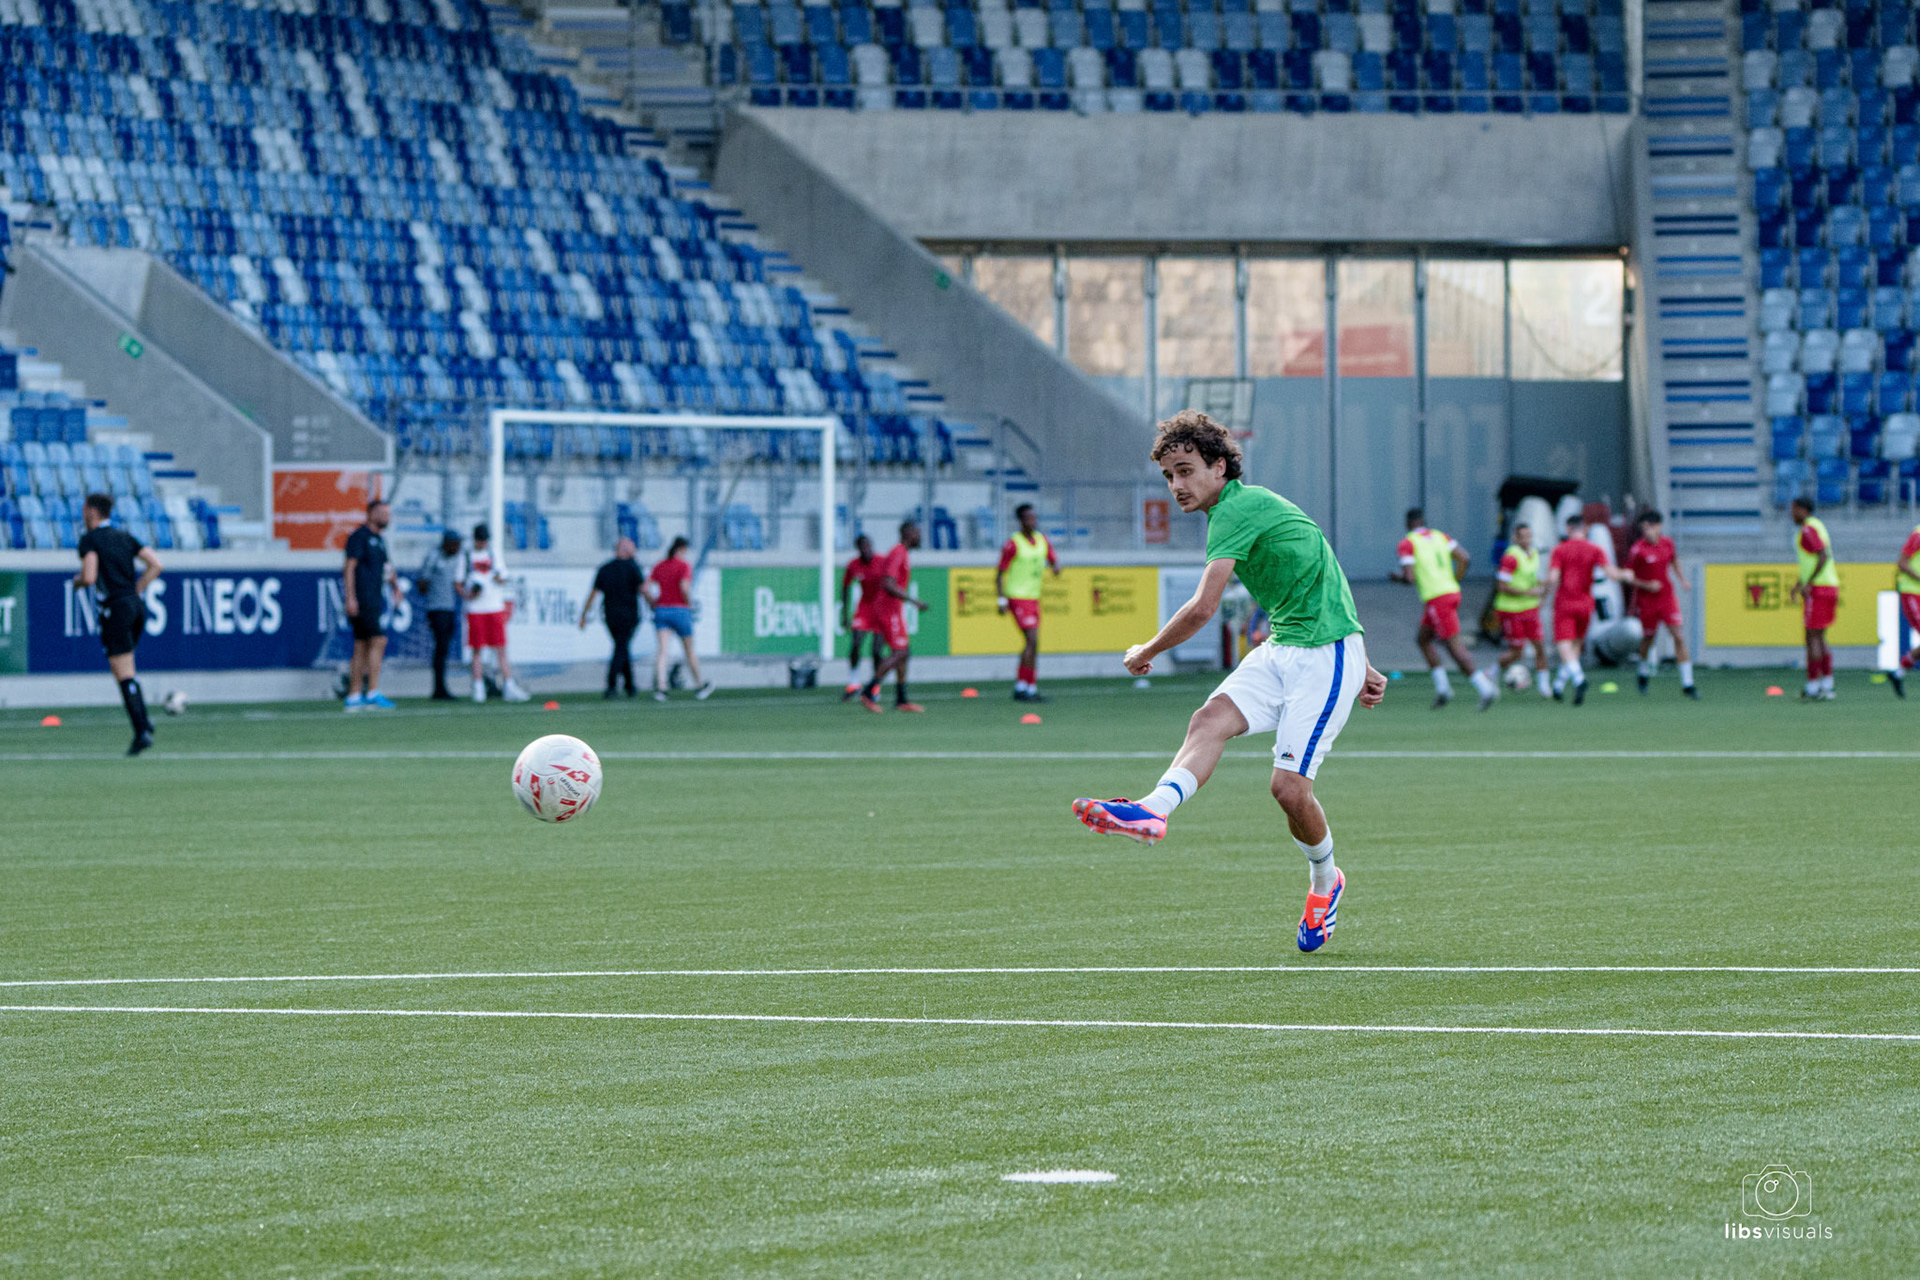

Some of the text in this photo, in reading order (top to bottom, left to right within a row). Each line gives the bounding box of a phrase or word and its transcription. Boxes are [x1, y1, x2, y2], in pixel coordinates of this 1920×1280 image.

[64, 578, 167, 637] INS
[183, 577, 281, 634] INEOS
[318, 577, 412, 633] INS
